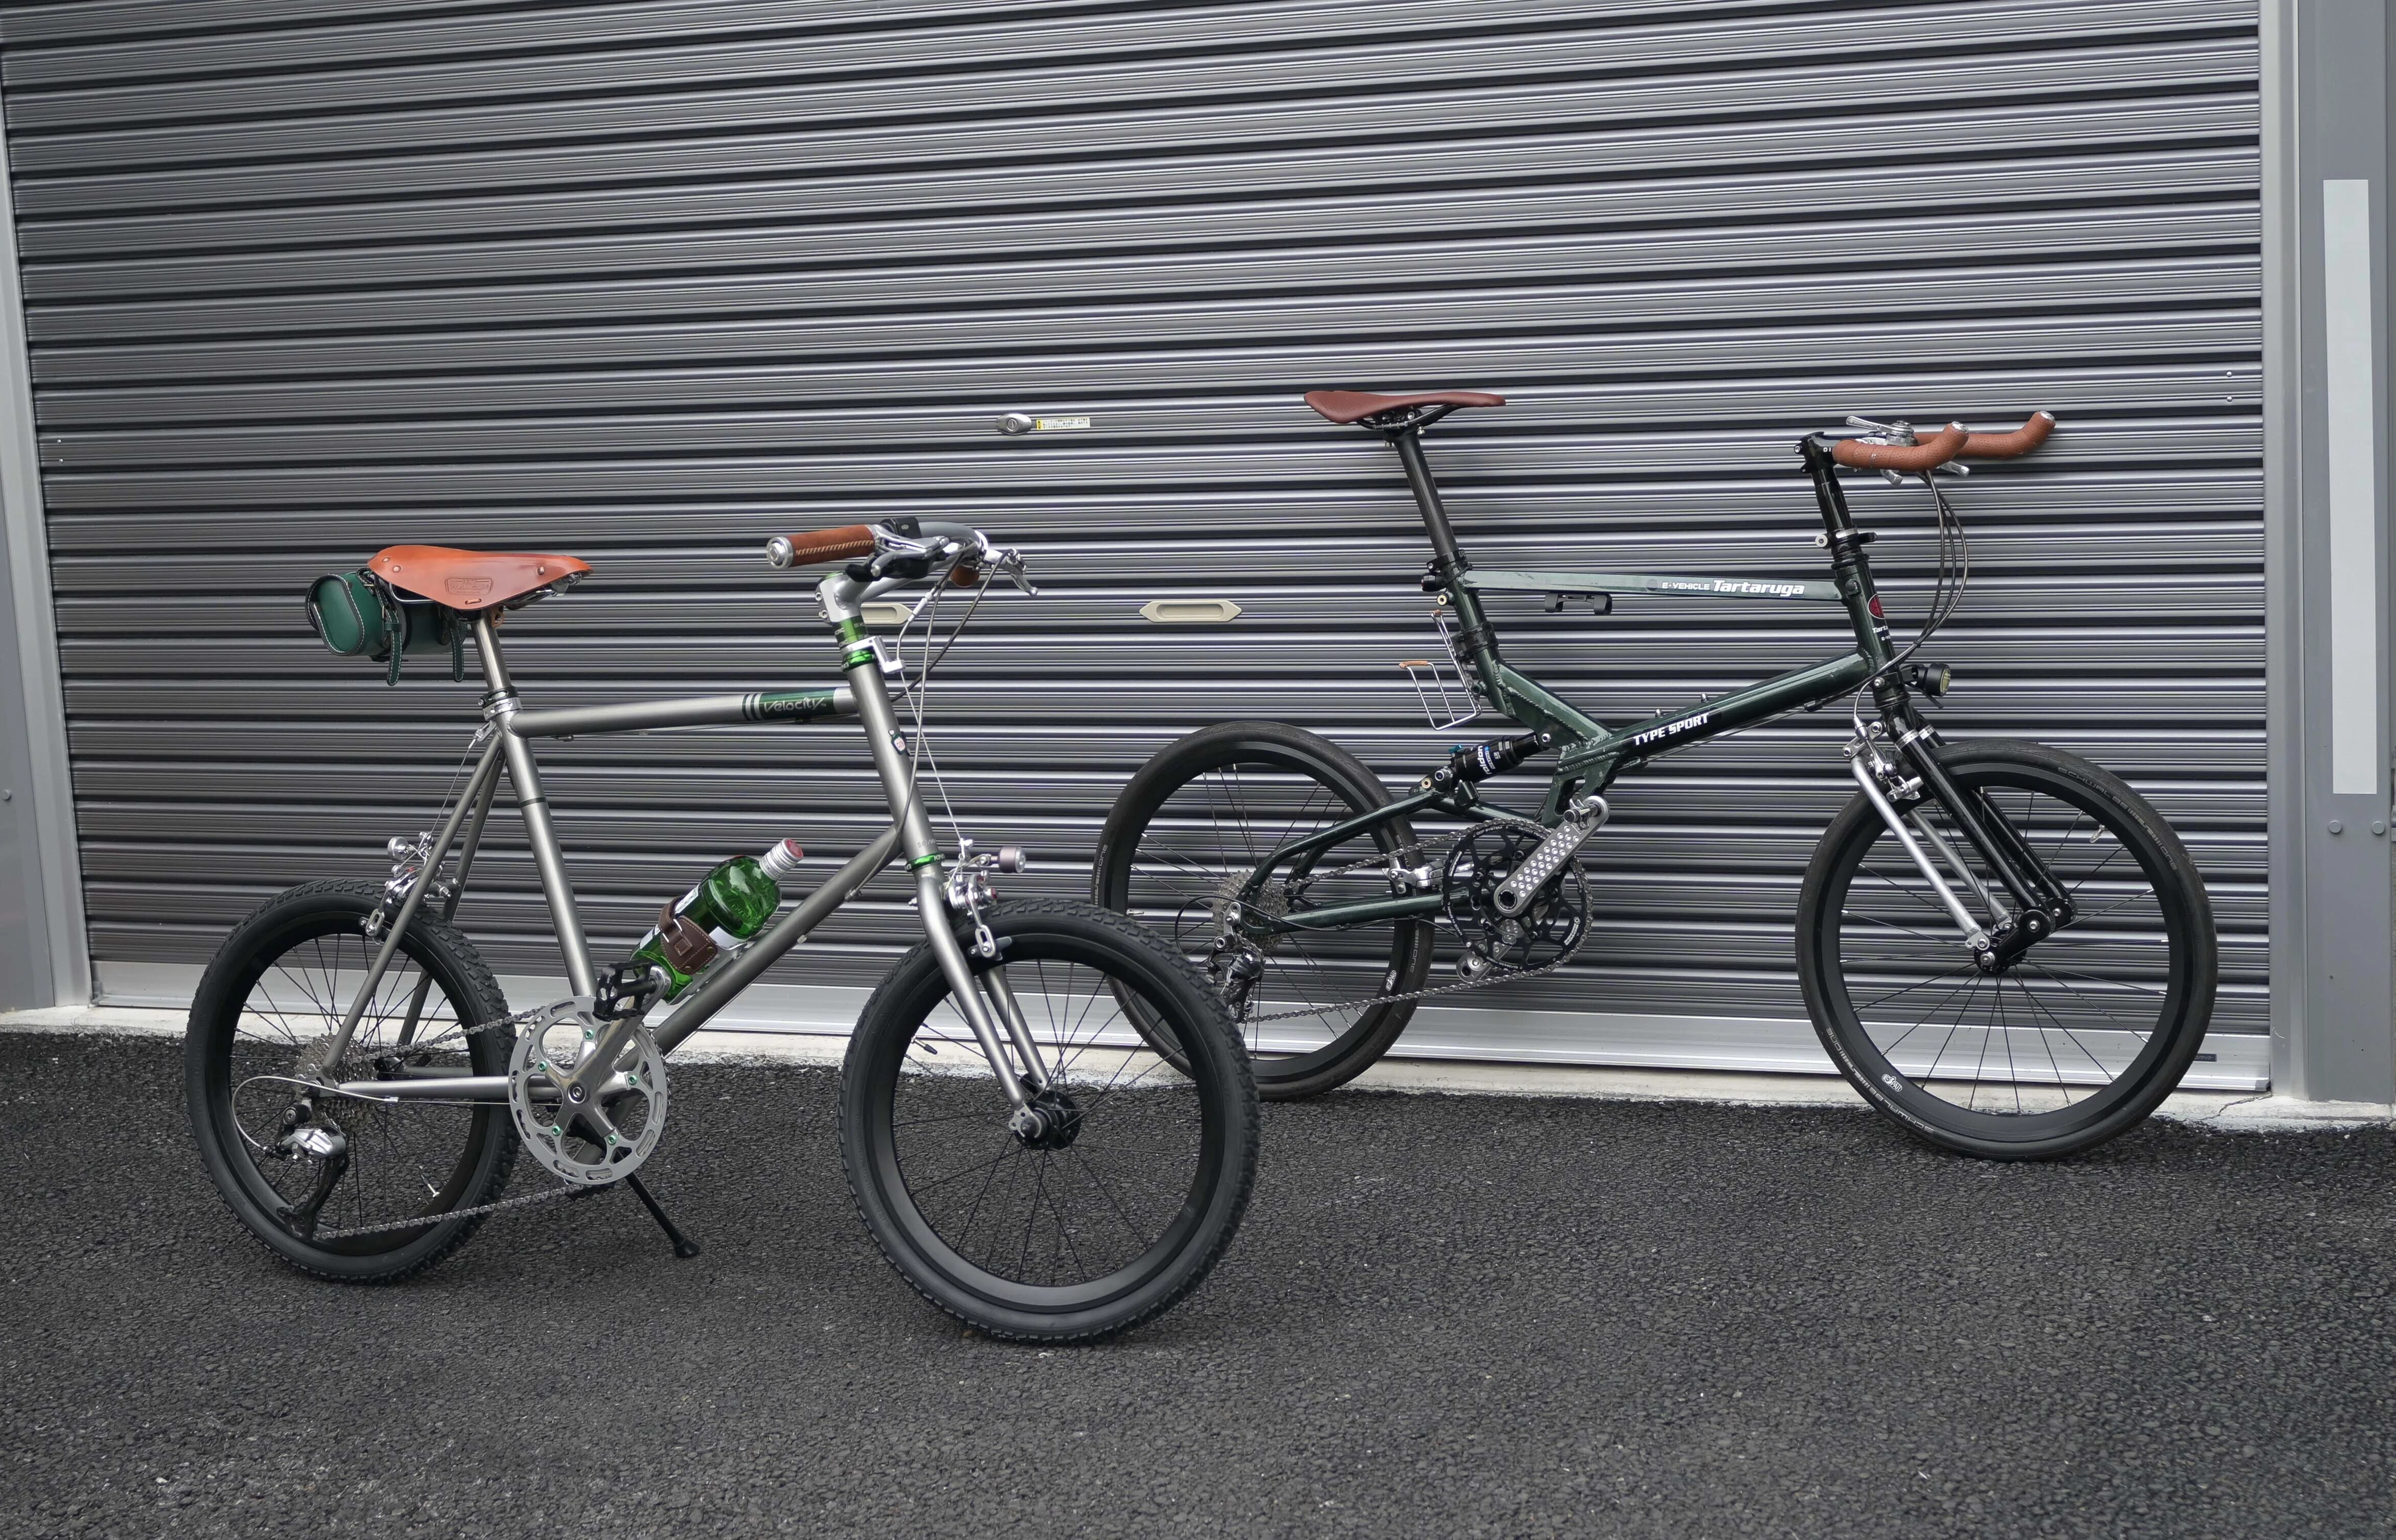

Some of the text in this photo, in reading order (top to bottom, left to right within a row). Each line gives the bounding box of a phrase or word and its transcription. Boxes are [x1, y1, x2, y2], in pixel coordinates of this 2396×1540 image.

[1713, 579, 1805, 597] Tartaruga
[764, 697, 825, 712] Velocity
[1633, 713, 1709, 746] TYPE SPORT
